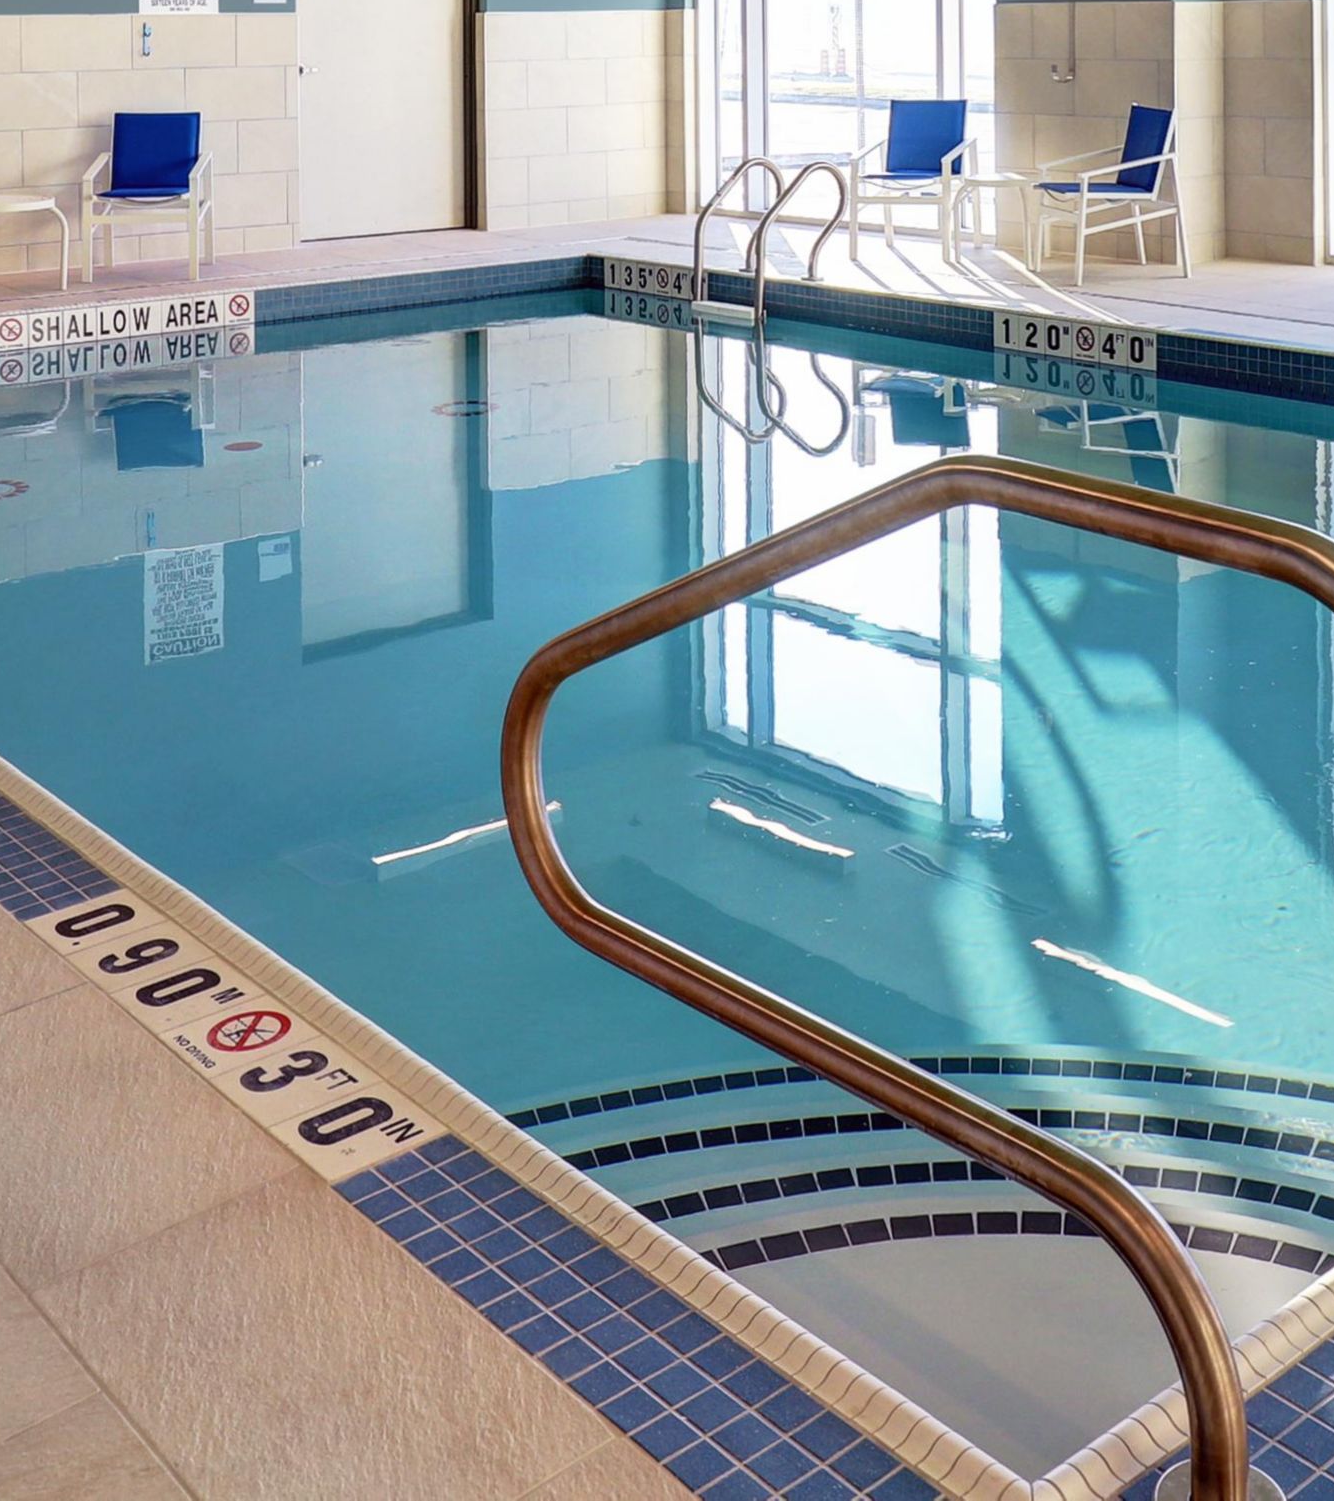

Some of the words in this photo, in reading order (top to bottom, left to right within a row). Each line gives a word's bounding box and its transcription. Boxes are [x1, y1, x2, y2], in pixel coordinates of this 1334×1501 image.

[31, 306, 152, 342] SHALLOW
[165, 299, 219, 328] AREA
[173, 1034, 191, 1047] NO
[185, 1045, 216, 1069] DIVING
